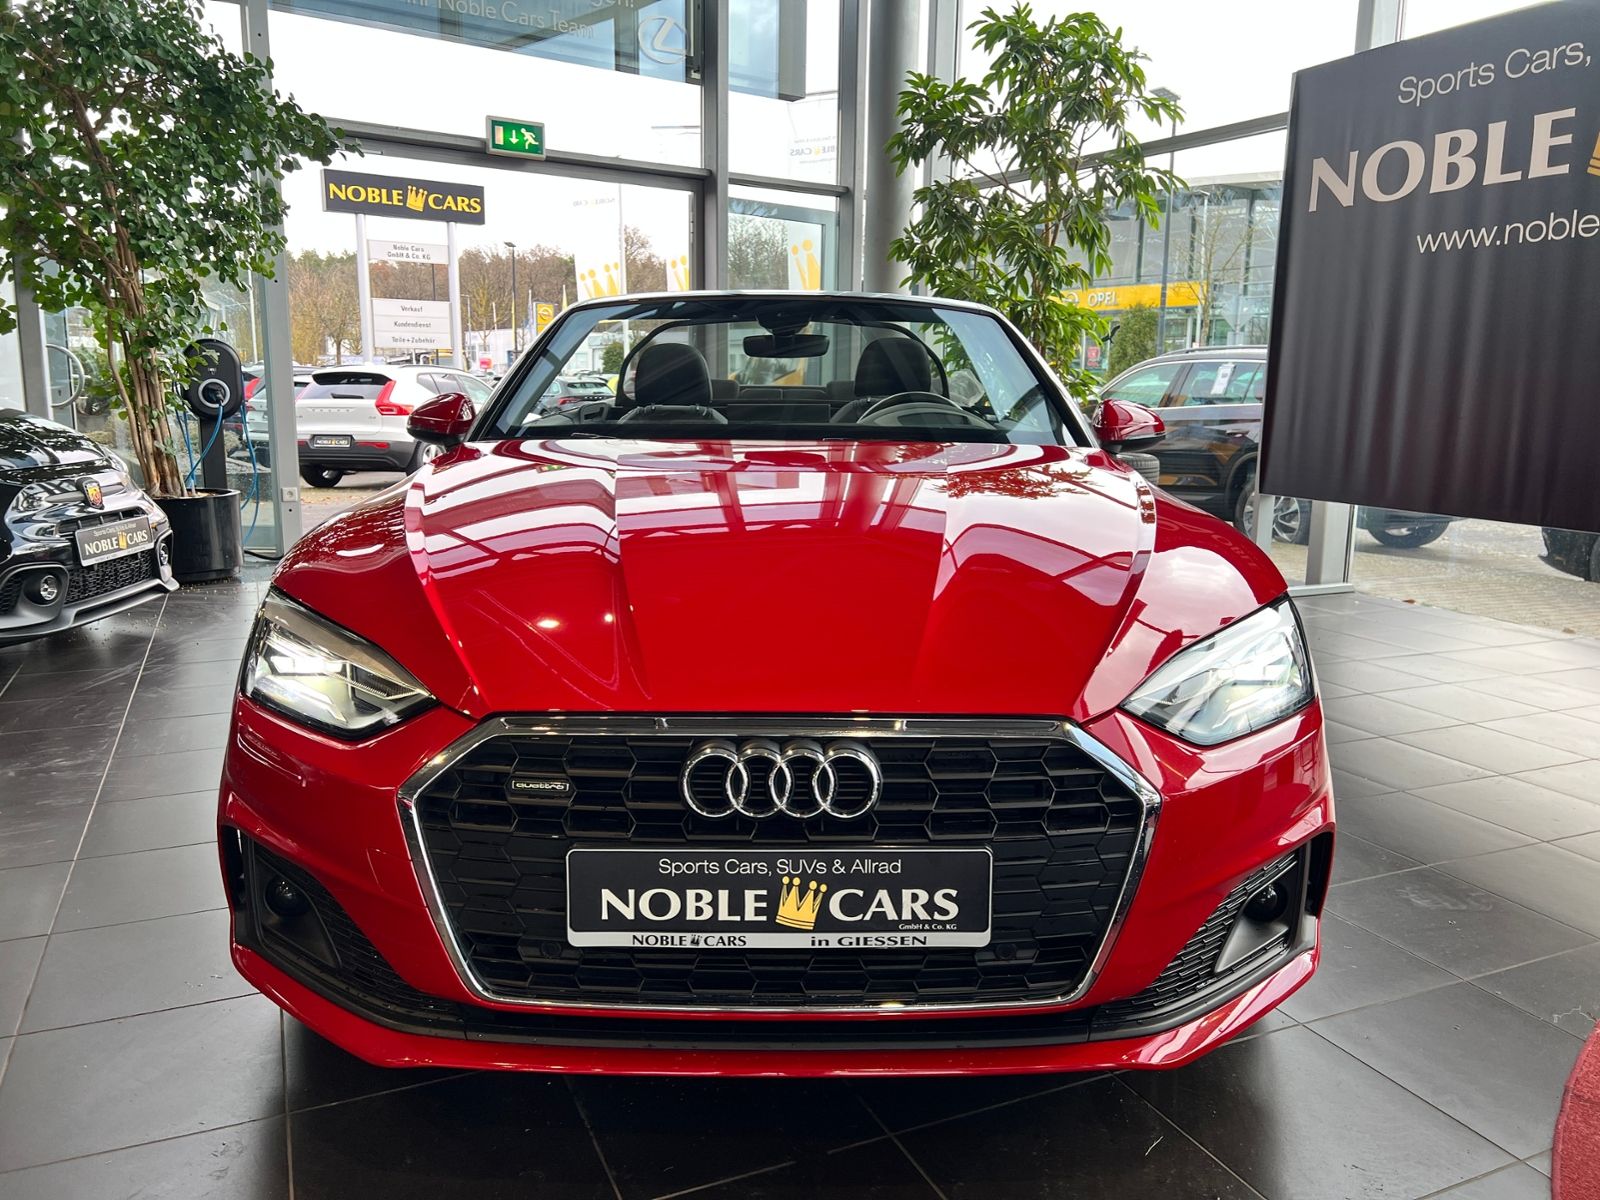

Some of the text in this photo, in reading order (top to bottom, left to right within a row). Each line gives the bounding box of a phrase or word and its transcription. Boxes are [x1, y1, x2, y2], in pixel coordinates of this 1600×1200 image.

[502, 1, 545, 28] Cars
[549, 9, 595, 38] Team
[1397, 42, 1592, 106] Sports Cars,
[1308, 107, 1577, 212] NOBLE
[328, 183, 482, 213] NOBLE CARS
[1416, 208, 1600, 254] www.noble
[387, 251, 404, 259] GmbH
[422, 253, 431, 261] KG
[393, 244, 409, 252] Noble
[1087, 291, 1119, 307] OPEL
[393, 321, 431, 329] Kundendienst
[84, 536, 119, 556] NOBLE
[126, 530, 148, 545] CARS
[516, 782, 564, 790] quattro
[658, 858, 902, 876] Sports Cars, SUVs & Allrad
[600, 887, 960, 922] NOBLE CARS
[632, 934, 929, 947] NOBLE CARS in GIESSEN
